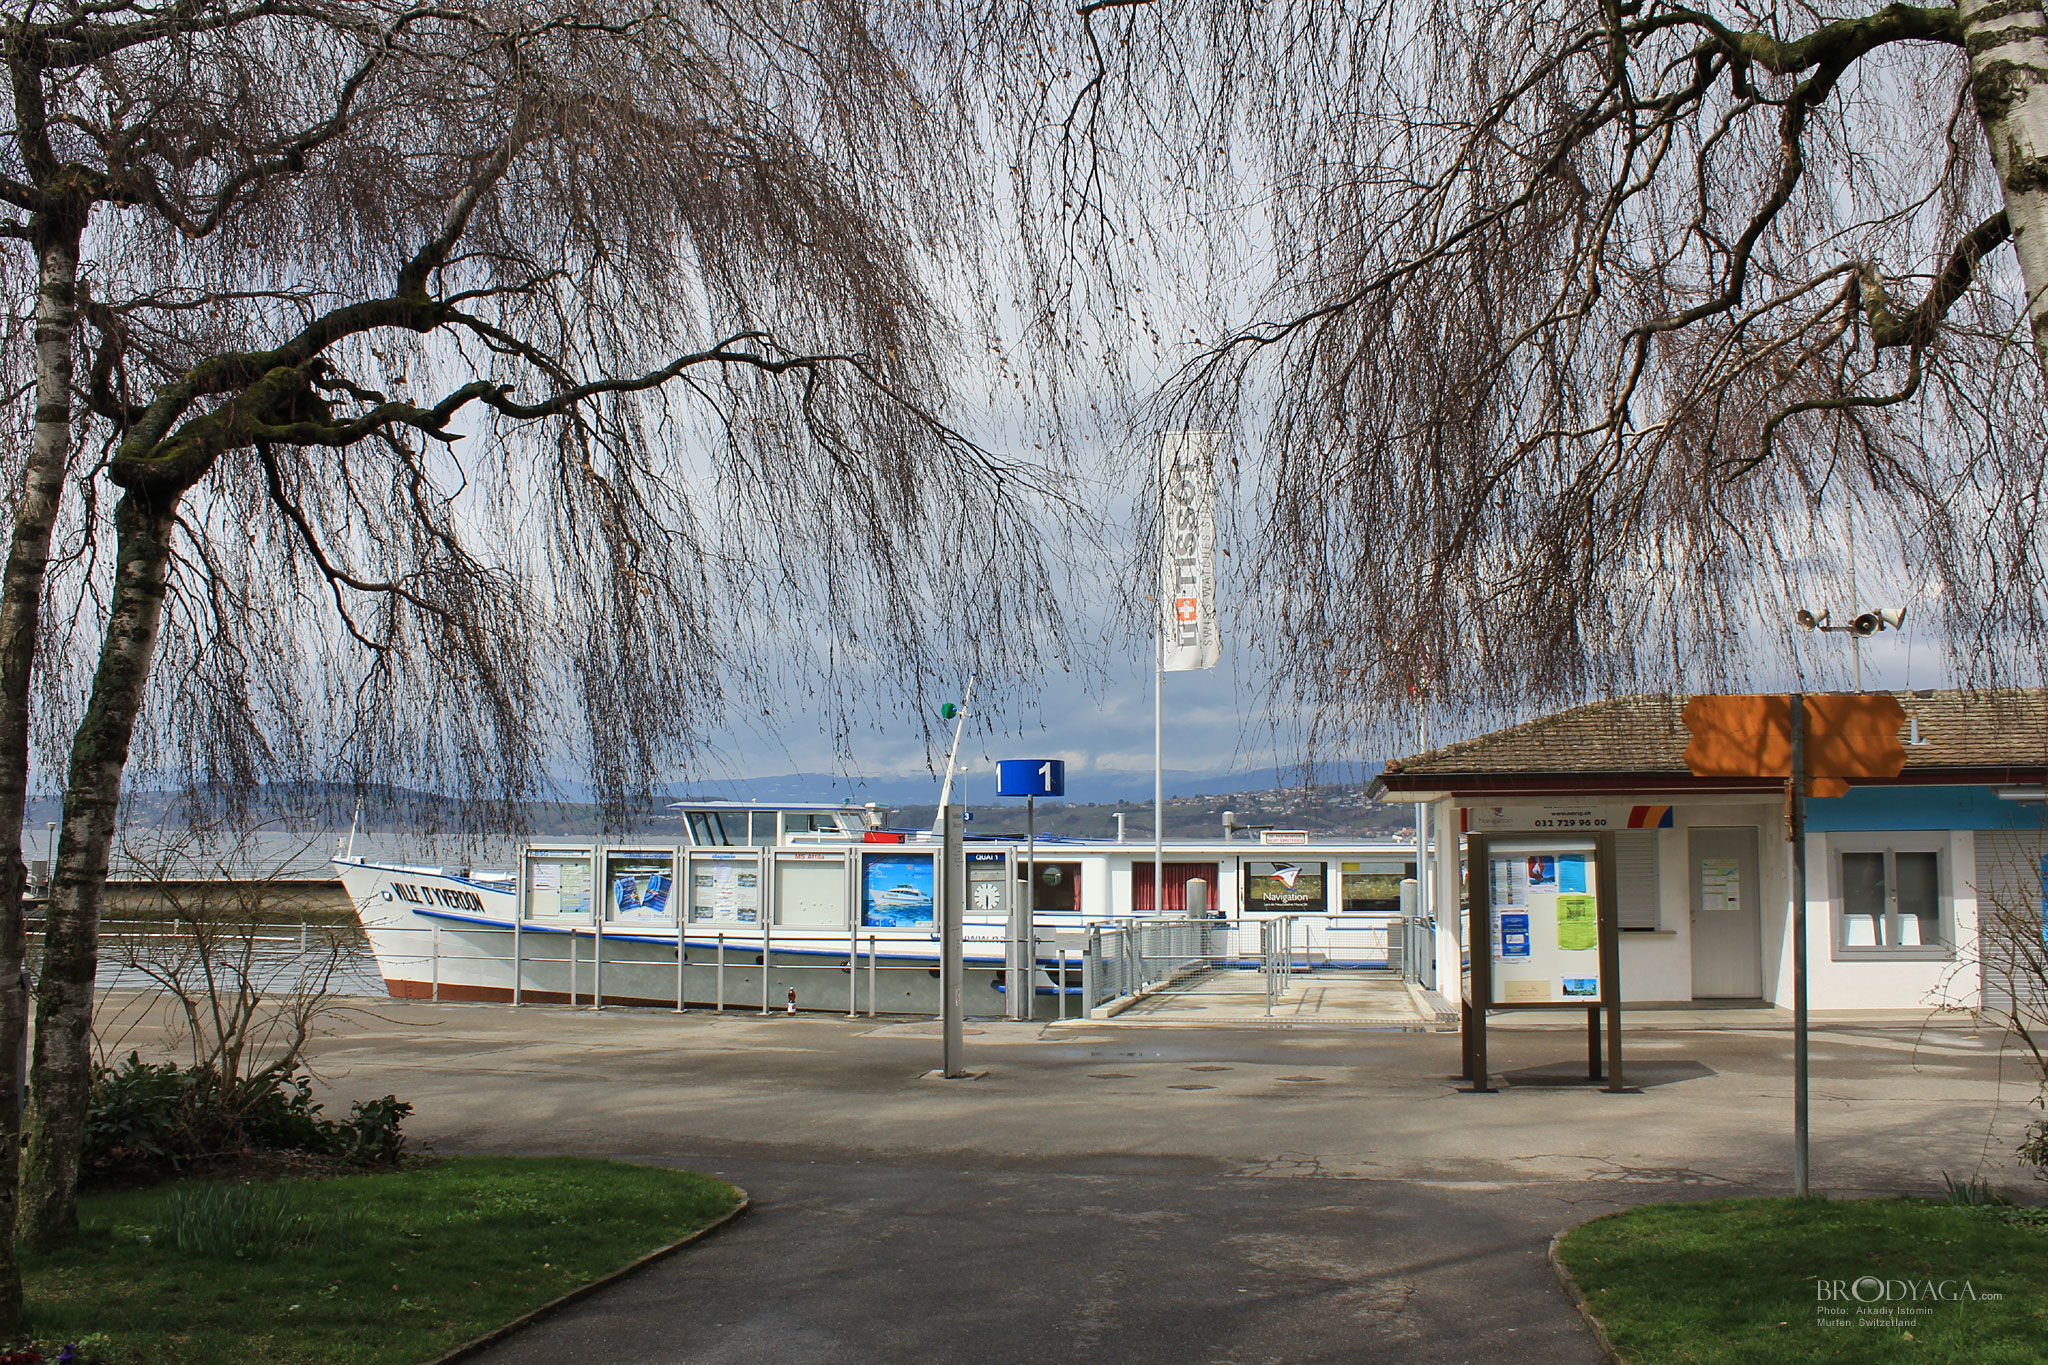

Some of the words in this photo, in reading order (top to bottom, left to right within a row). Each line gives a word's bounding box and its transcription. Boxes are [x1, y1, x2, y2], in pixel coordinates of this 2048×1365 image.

[1200, 535, 1212, 599] WATCHES
[1202, 602, 1213, 646] SWISS
[1038, 761, 1051, 792] 1
[964, 812, 970, 820] 3
[1534, 819, 1554, 827] 032
[1556, 819, 1576, 827] 729
[1578, 819, 1592, 827] 96
[1594, 818, 1607, 826] 00
[390, 882, 423, 904] VILLE
[1263, 892, 1308, 903] Navigation
